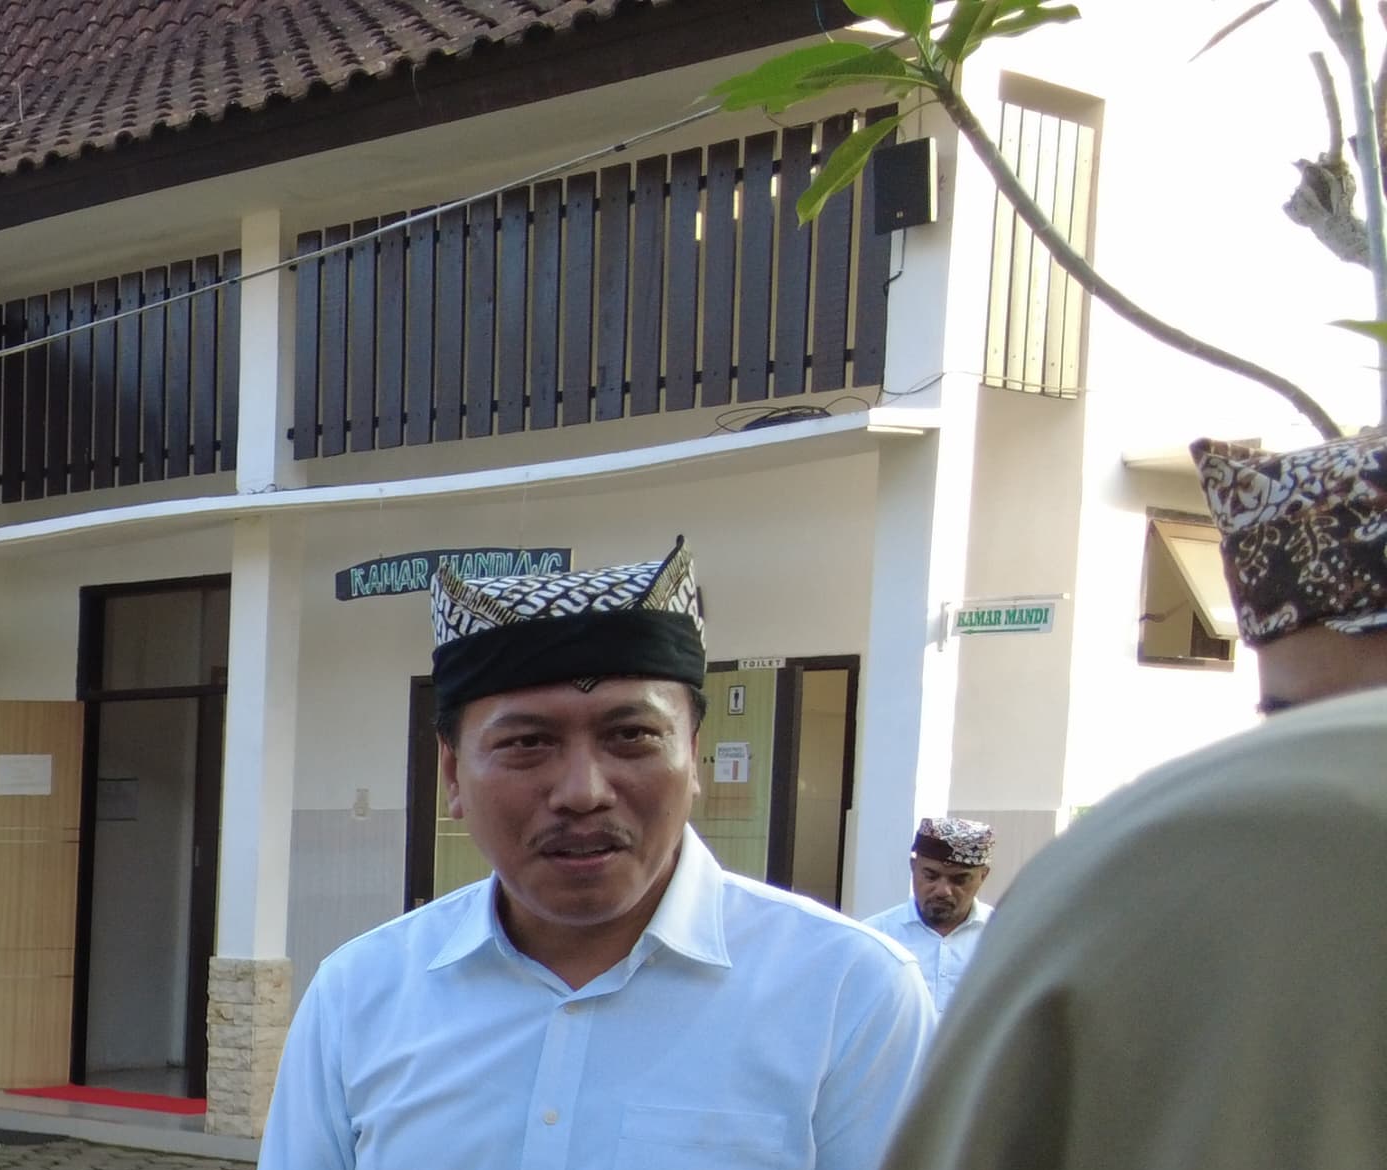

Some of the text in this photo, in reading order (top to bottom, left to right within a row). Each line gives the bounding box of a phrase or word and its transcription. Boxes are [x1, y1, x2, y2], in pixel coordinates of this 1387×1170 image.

[350, 557, 428, 597] KAMAR
[956, 607, 1050, 627] KAMAR MANDI
[742, 659, 781, 668] TOILET
